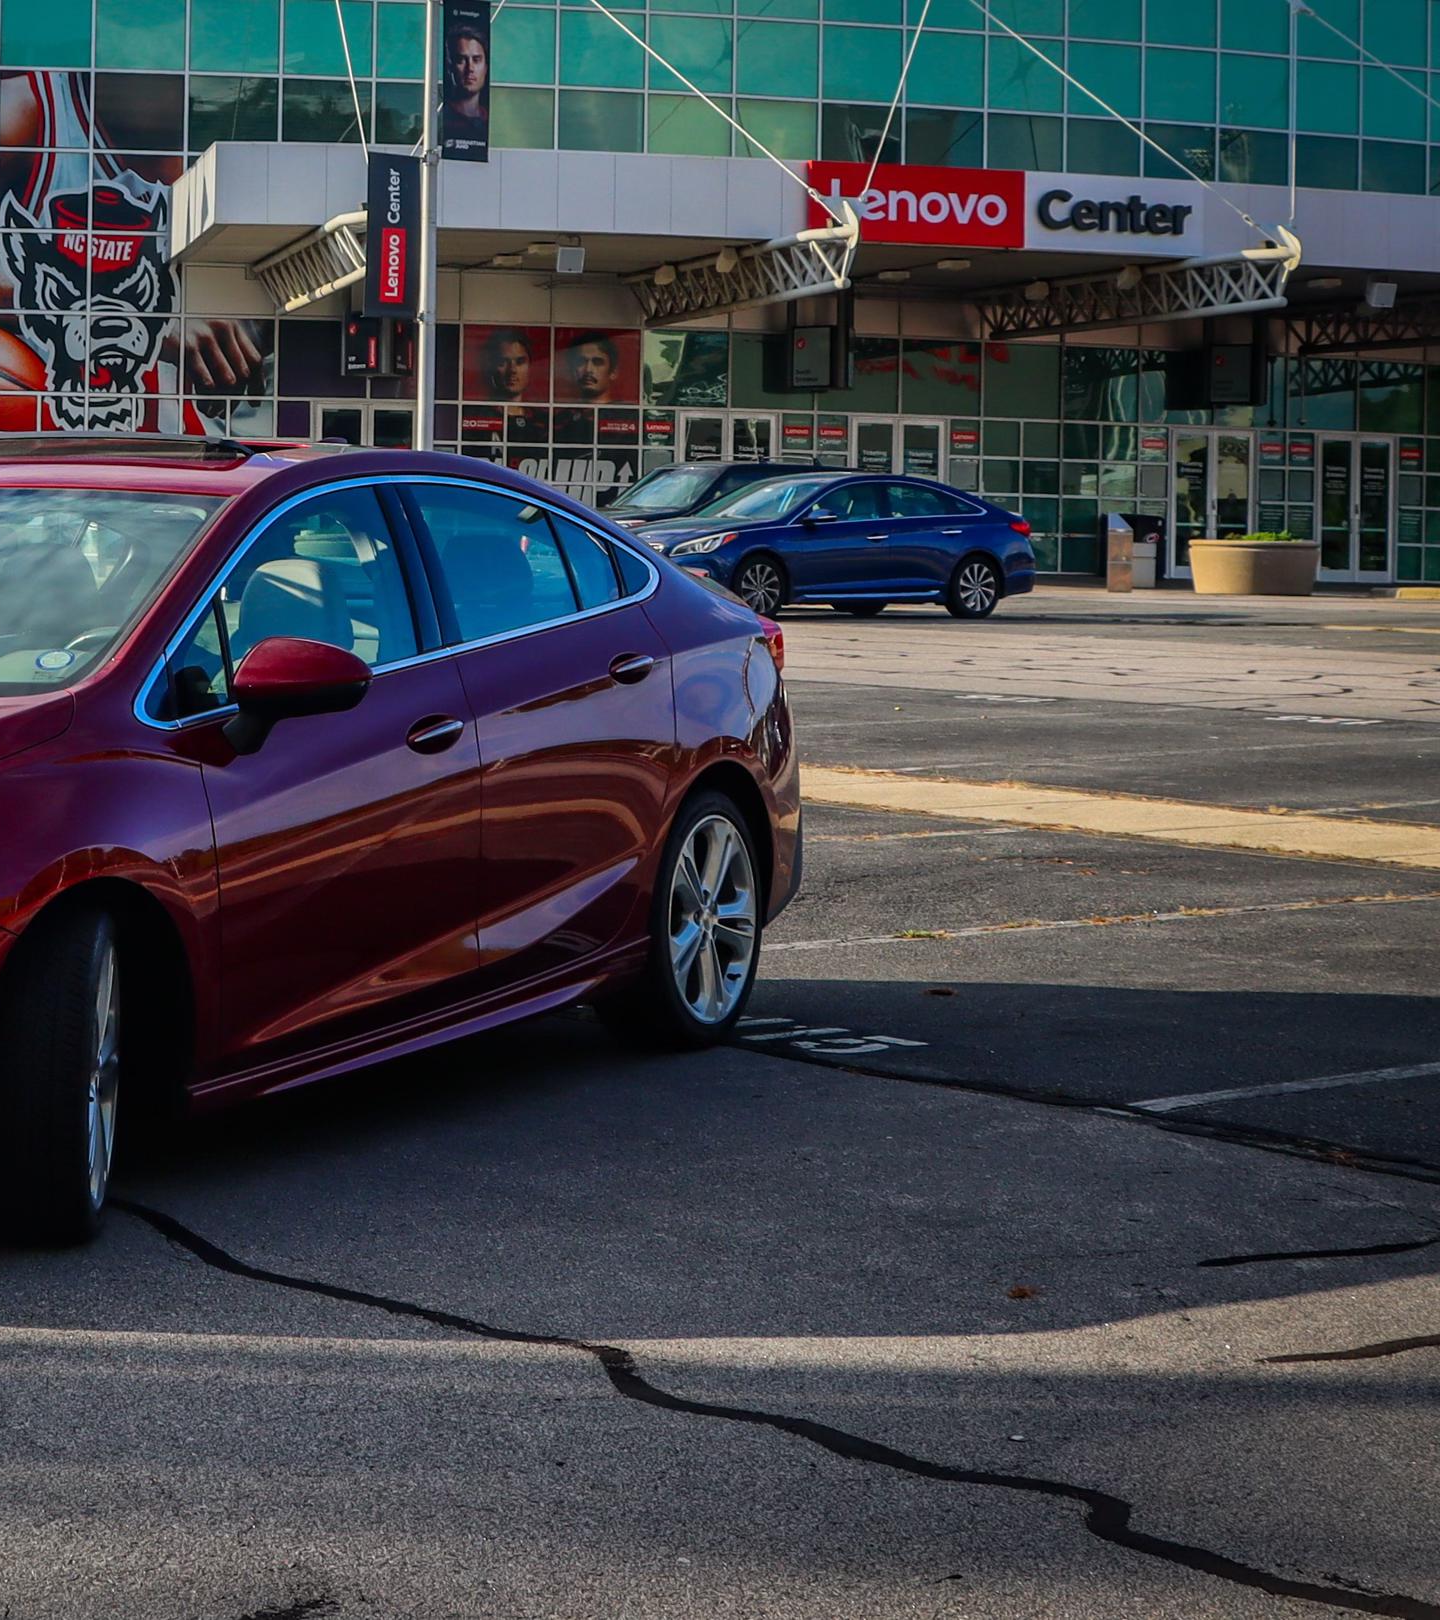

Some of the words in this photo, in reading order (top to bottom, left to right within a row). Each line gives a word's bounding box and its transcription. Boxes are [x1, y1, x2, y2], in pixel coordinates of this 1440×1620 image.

[387, 168, 400, 224] Center
[1037, 189, 1192, 235] Center
[63, 229, 86, 253] NC
[90, 237, 134, 261] STATE
[385, 234, 400, 297] Lenovo
